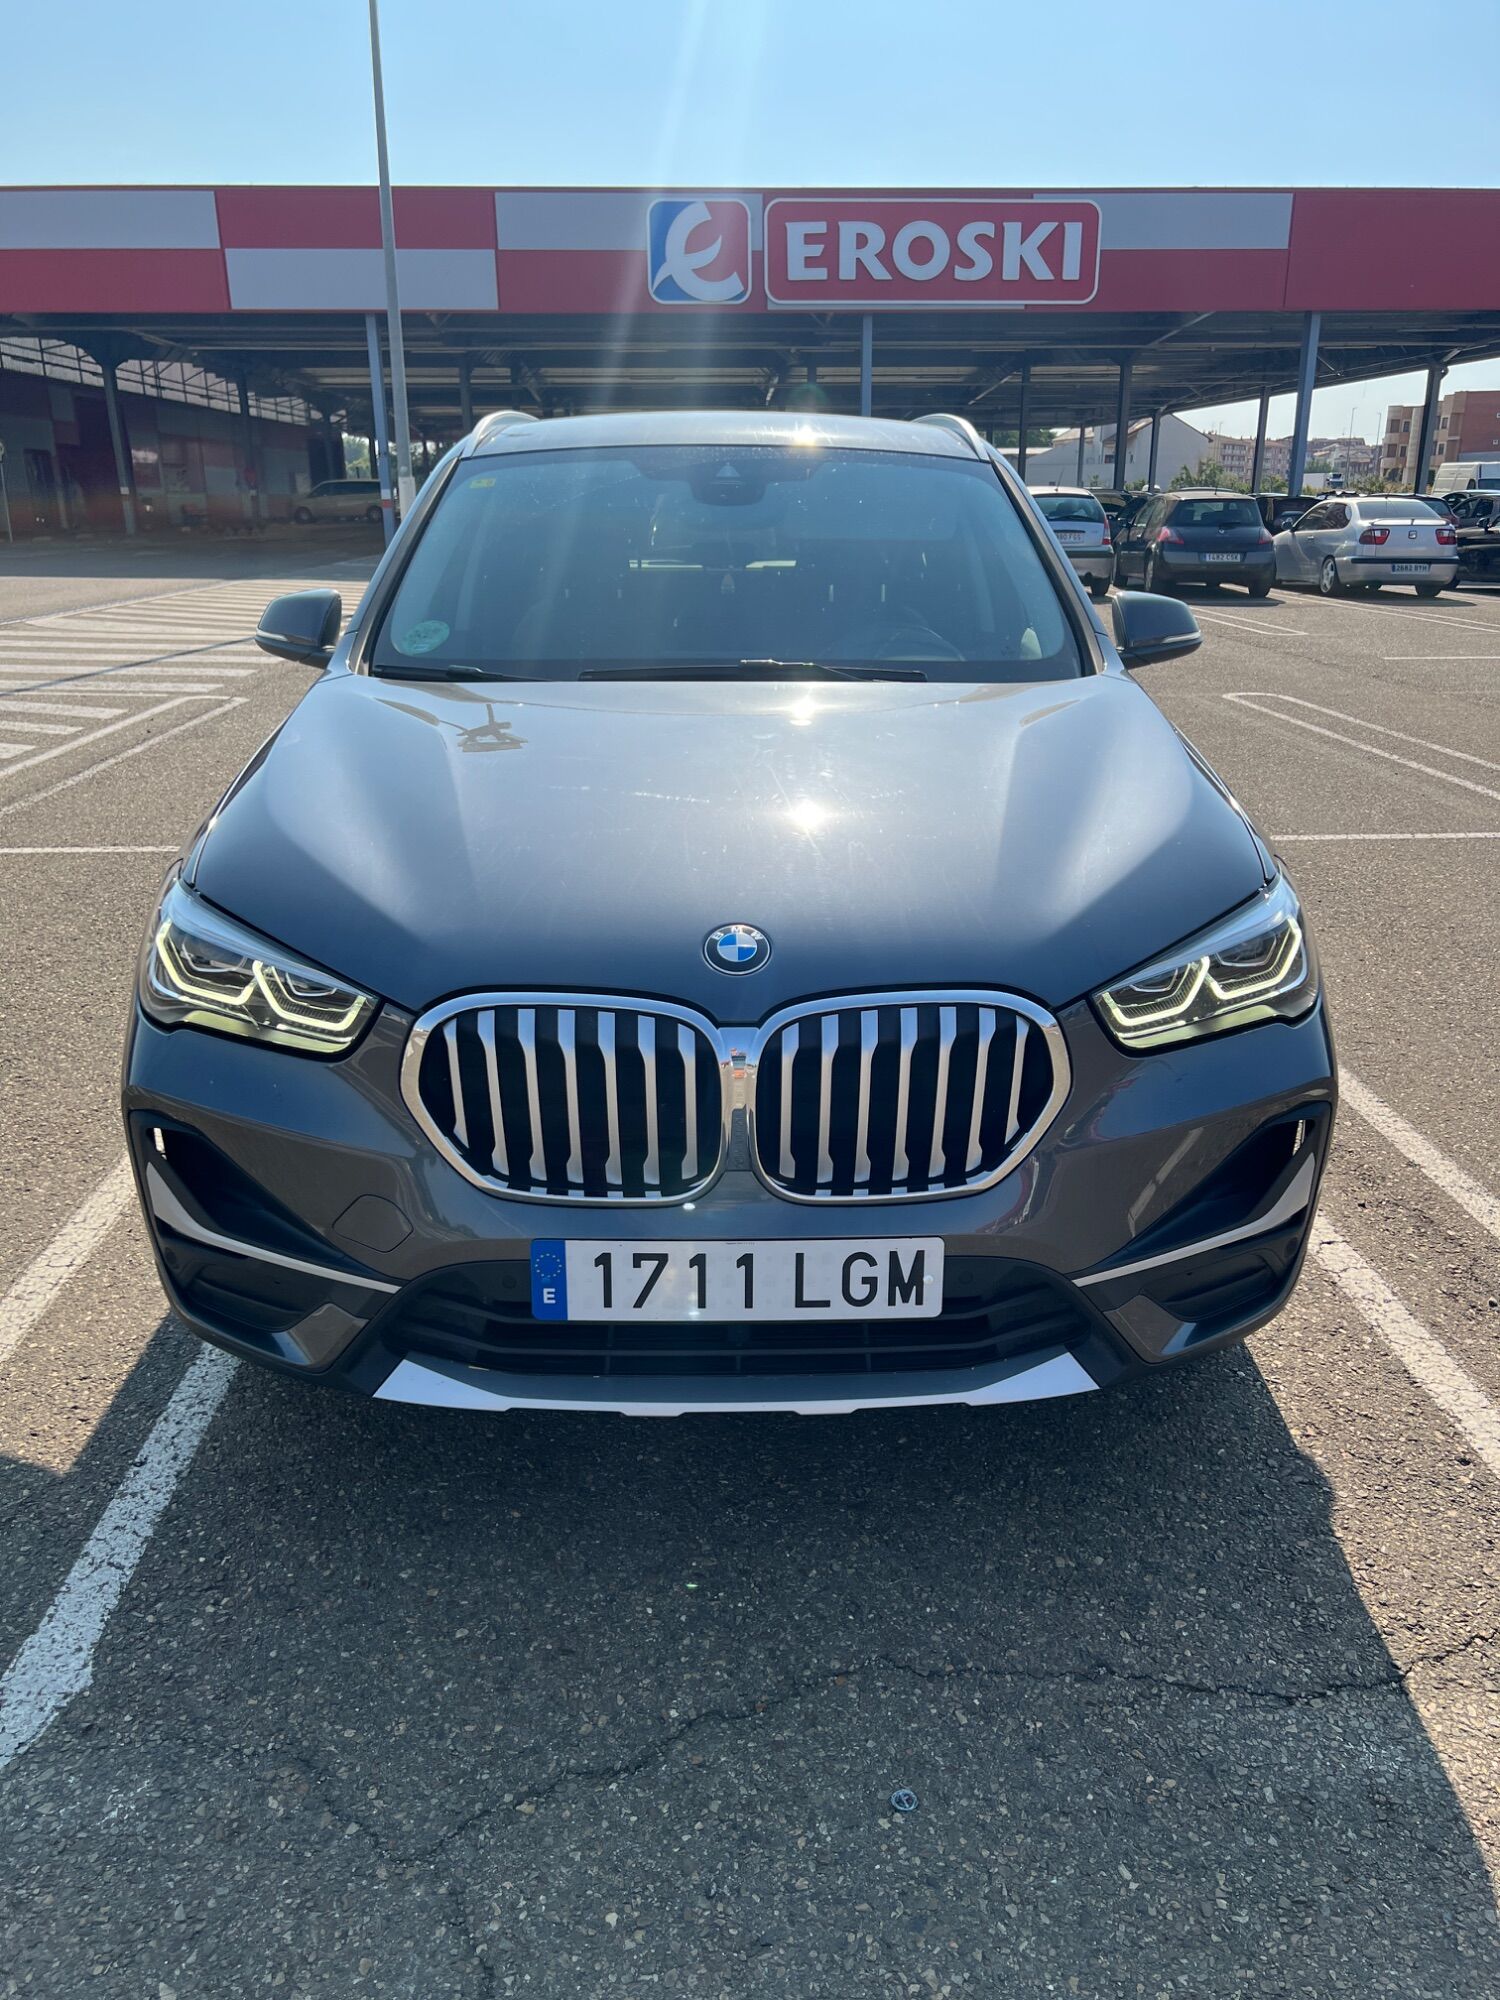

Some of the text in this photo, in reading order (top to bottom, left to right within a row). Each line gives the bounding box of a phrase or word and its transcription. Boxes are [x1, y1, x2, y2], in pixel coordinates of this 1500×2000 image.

[785, 220, 1083, 281] EROSKI
[711, 926, 764, 941] BMW
[543, 1288, 556, 1304] E
[594, 1249, 925, 1309] 1711 LGM
